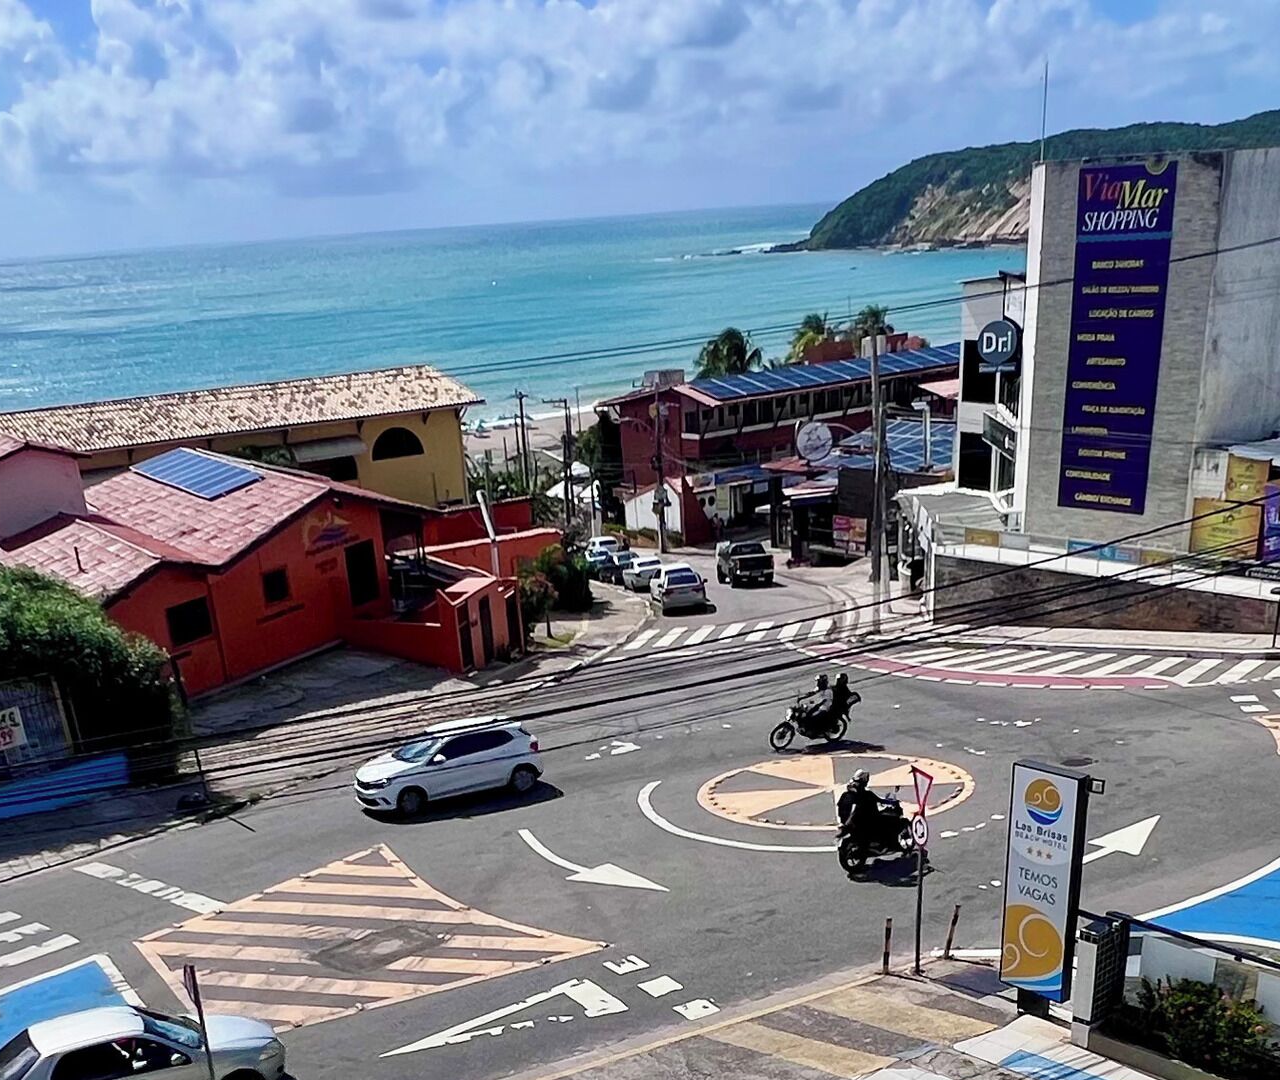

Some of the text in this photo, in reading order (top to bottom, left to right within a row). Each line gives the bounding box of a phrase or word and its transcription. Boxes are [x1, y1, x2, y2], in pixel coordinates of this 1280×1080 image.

[1082, 208, 1160, 232] SHOPPING
[1015, 820, 1068, 843] Las Brisas
[1018, 866, 1058, 889] TEMOS
[1017, 884, 1056, 906] VAGAS
